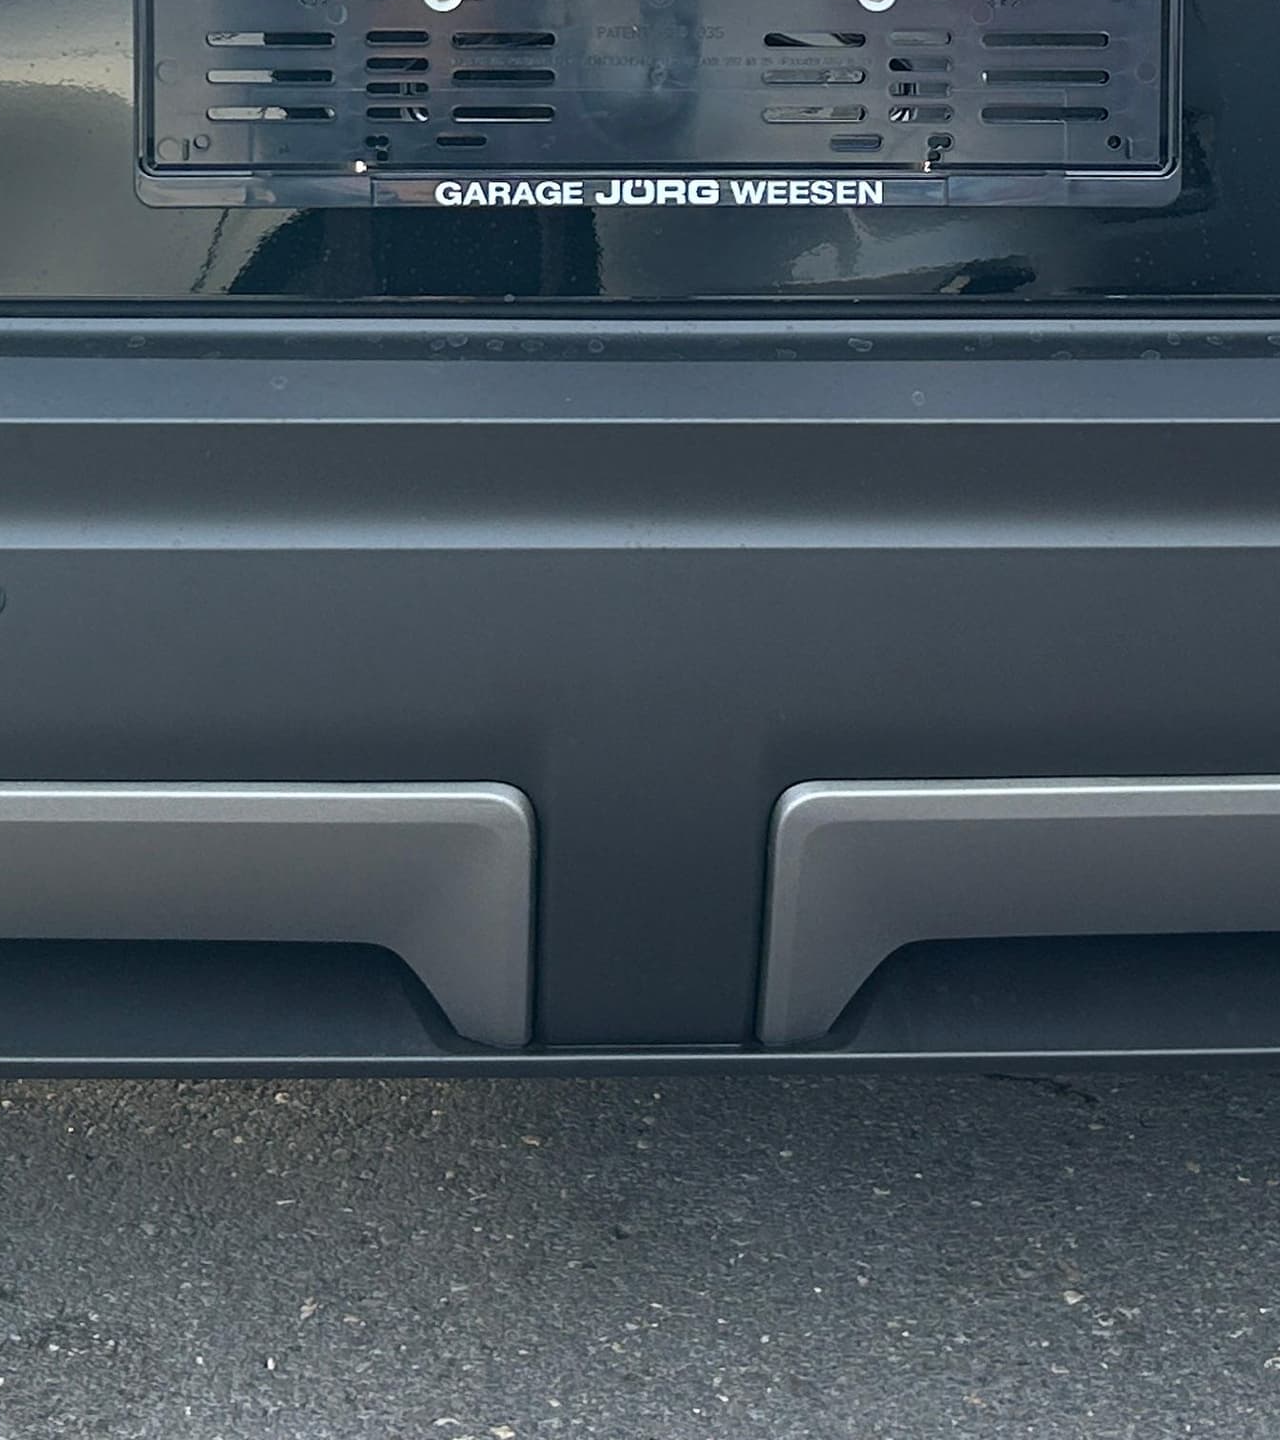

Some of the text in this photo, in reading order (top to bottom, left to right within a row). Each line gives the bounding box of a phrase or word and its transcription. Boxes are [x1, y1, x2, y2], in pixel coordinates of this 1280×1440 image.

[434, 178, 884, 206] GARAGE JÖRG WEESEN
